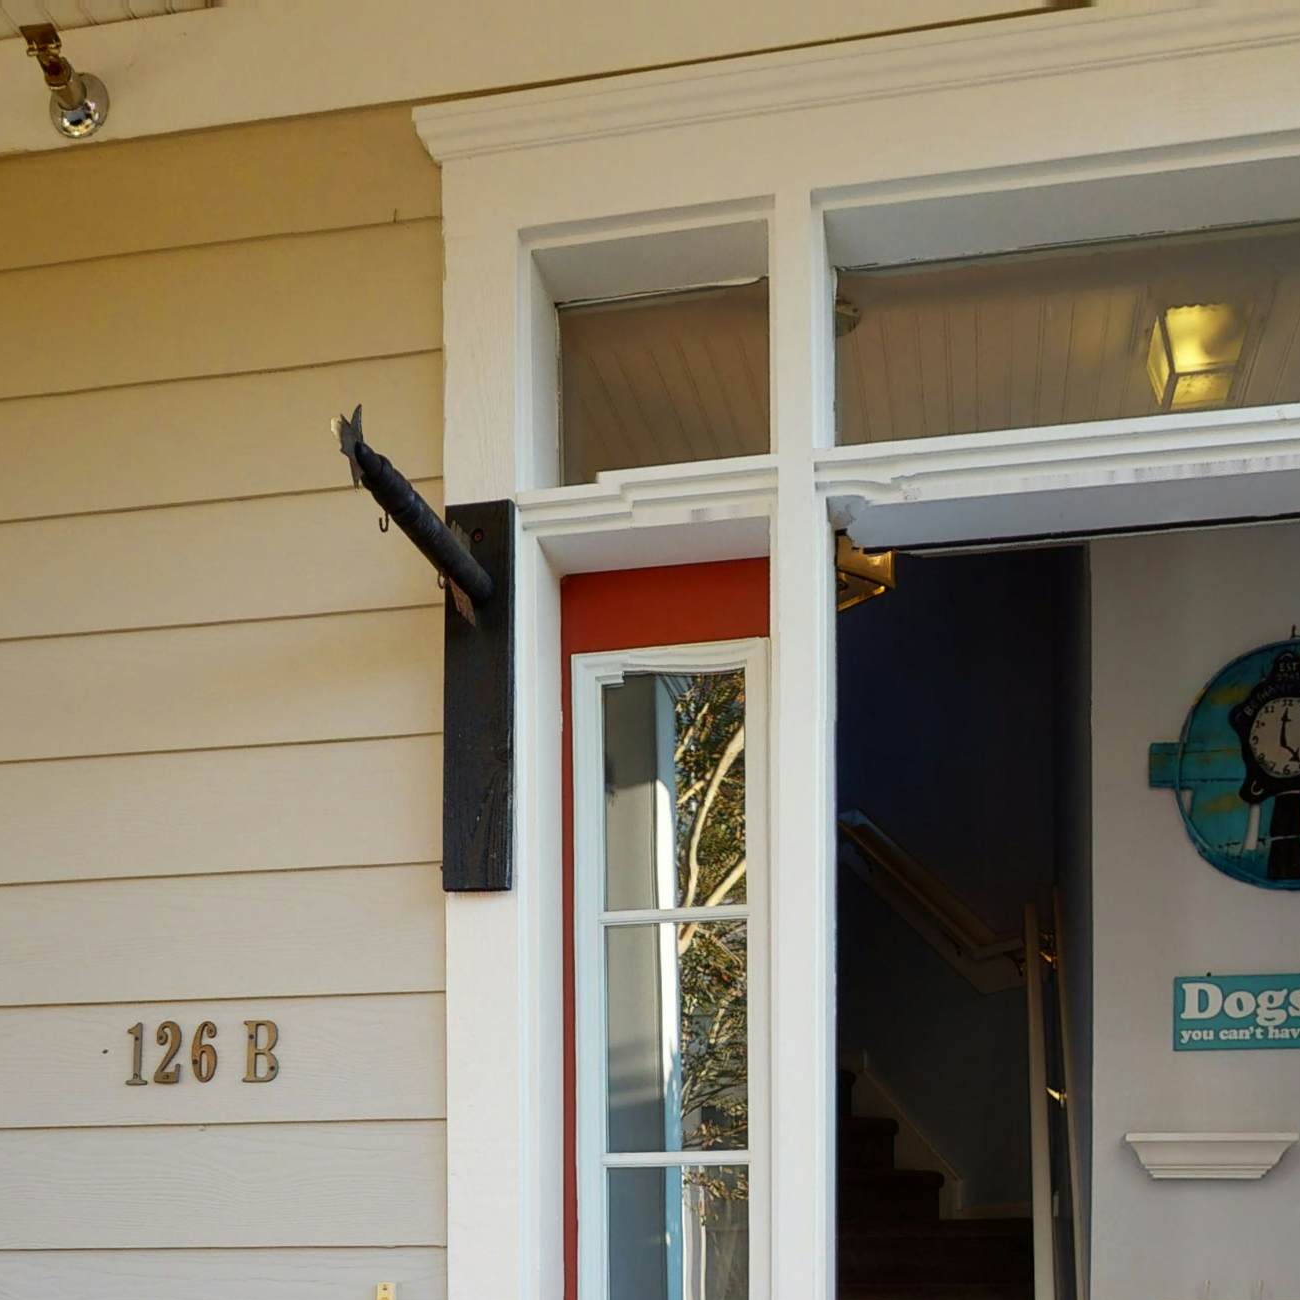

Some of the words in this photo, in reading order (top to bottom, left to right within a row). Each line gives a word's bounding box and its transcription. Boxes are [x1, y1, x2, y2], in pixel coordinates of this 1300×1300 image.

[1279, 662, 1299, 671] EST
[1283, 699, 1294, 707] 12
[1180, 1028, 1214, 1043] you
[1219, 1026, 1263, 1040] can't
[125, 1020, 218, 1086] 126
[242, 1020, 279, 1083] B
